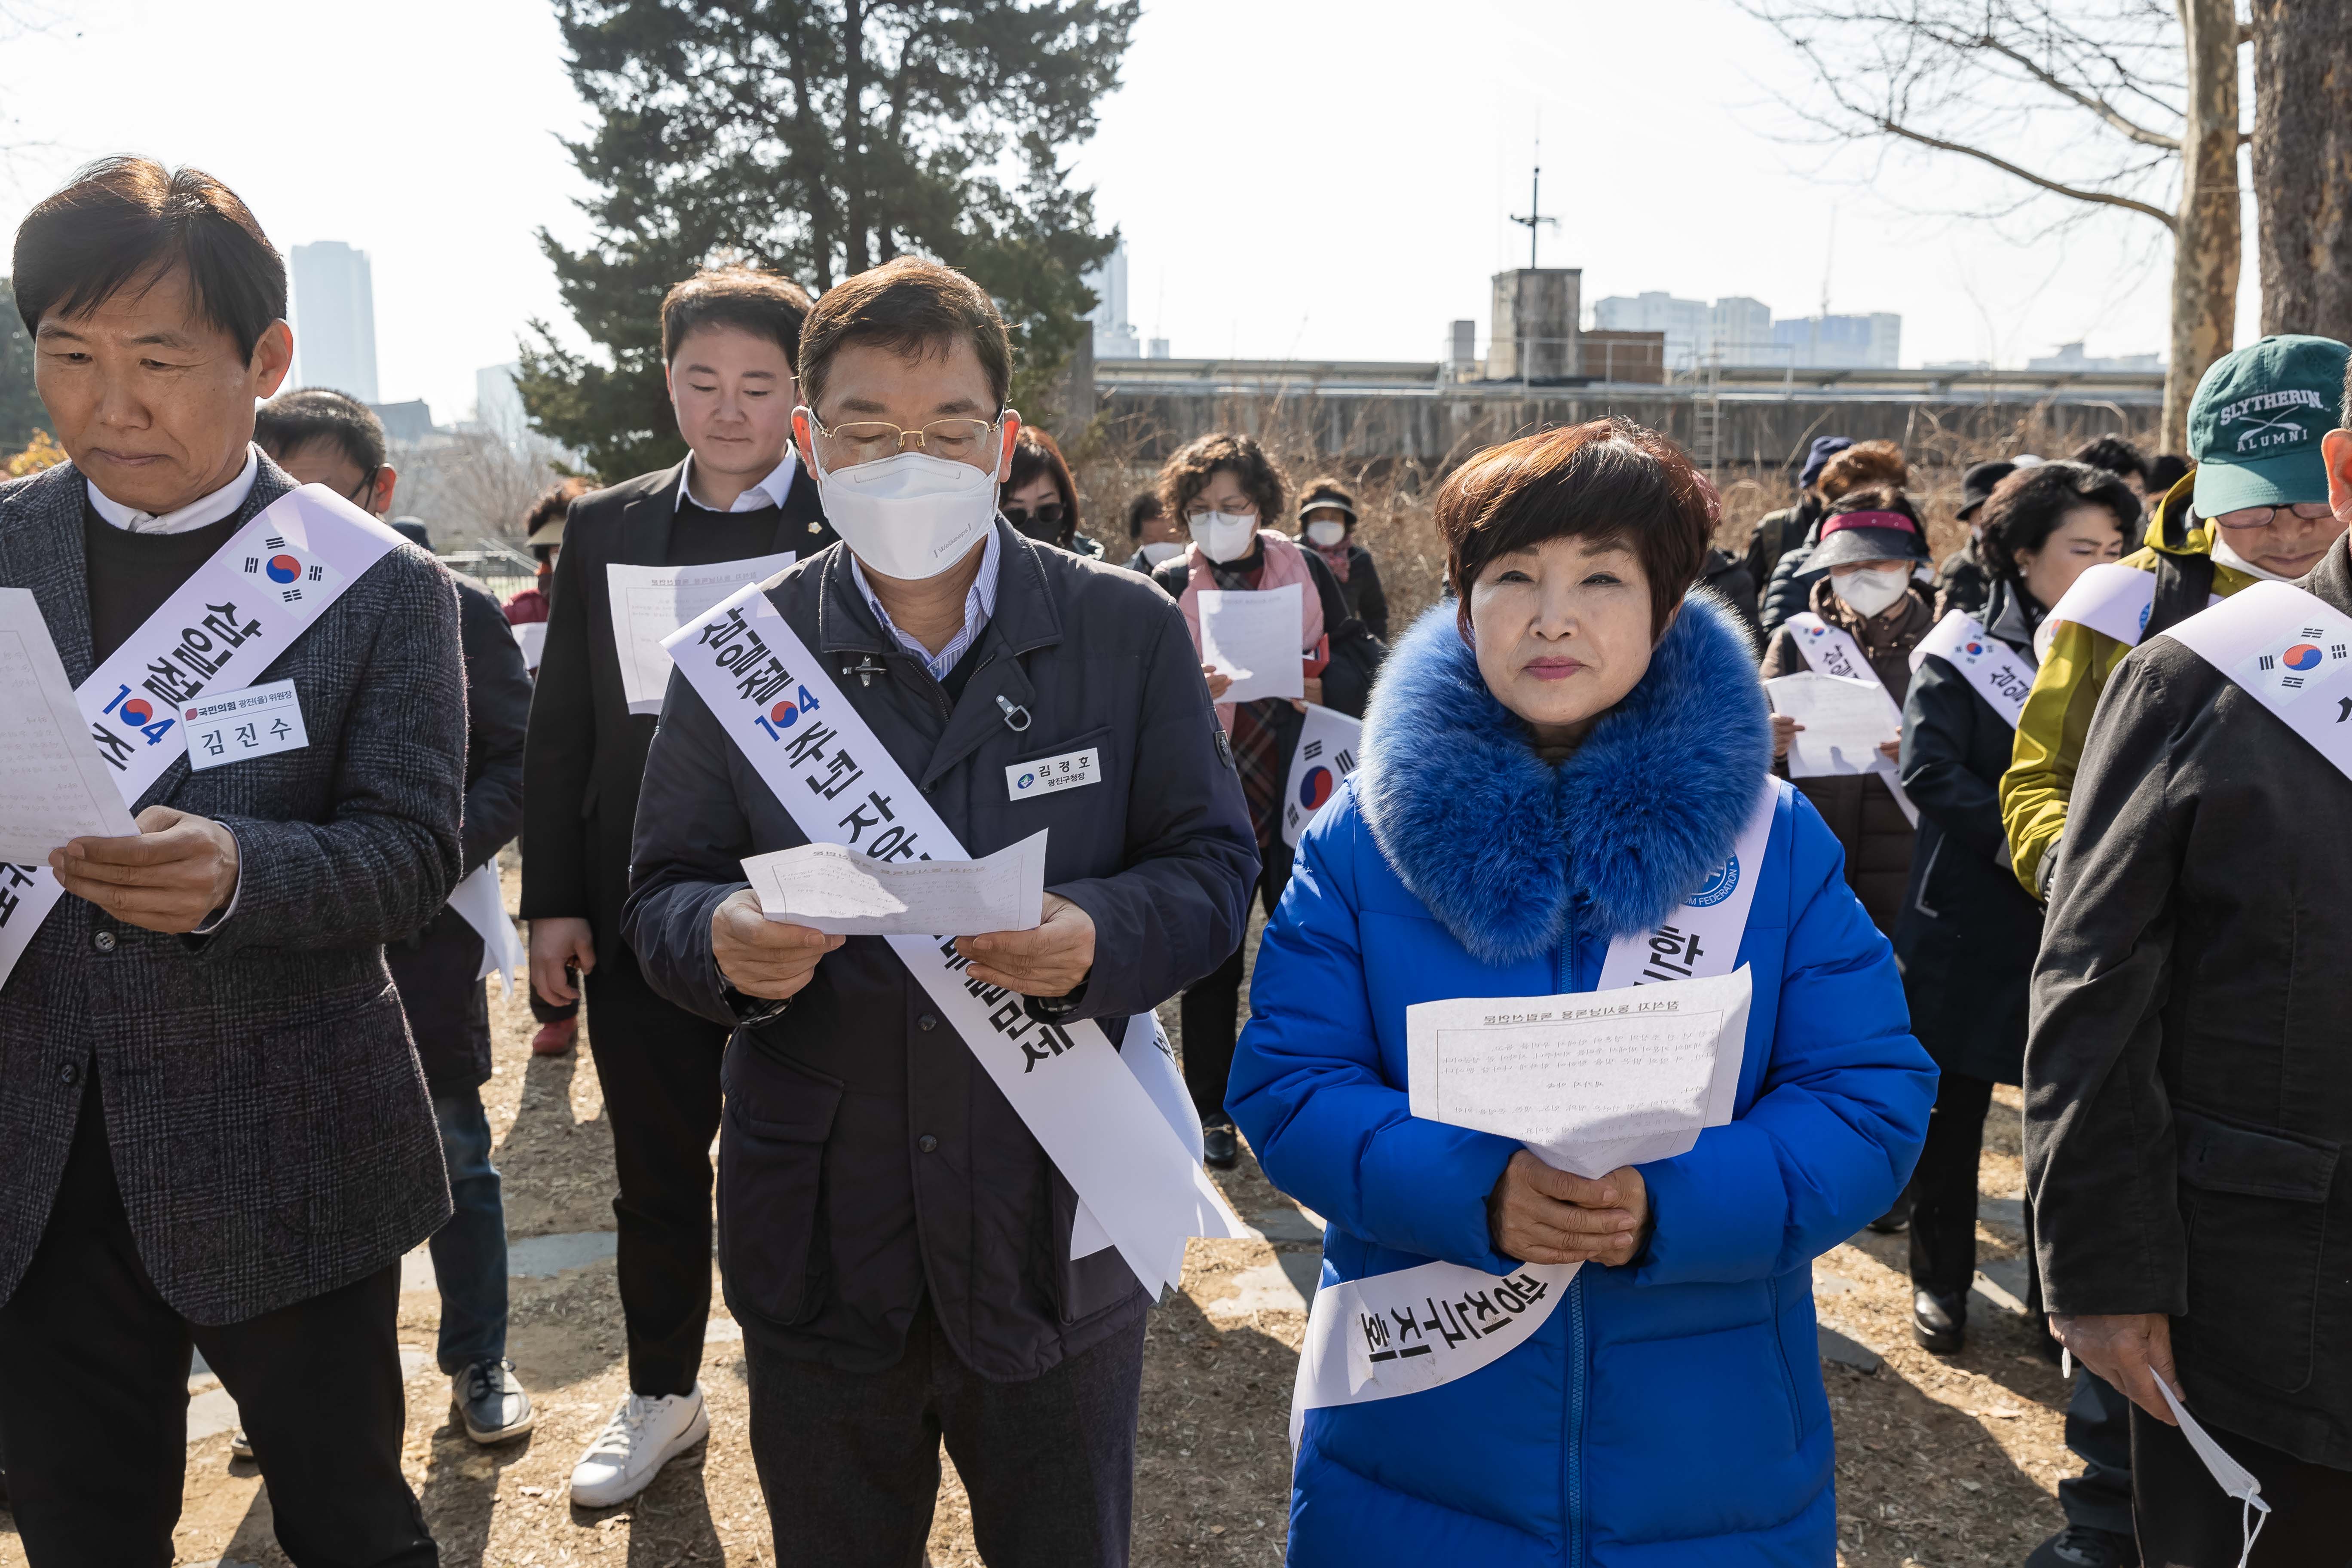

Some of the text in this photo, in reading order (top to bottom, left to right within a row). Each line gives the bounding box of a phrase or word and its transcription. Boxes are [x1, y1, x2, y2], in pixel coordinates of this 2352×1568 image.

[2220, 389, 2324, 426] SLYTHERIN
[2236, 429, 2307, 452] ALUMNI
[141, 601, 263, 711] 삼일절
[1822, 644, 1860, 679] 삼일
[198, 690, 292, 716] 국민의힘 광진(을) 위원장
[1990, 665, 2030, 708] 삼일
[697, 606, 795, 707] 삼일절
[784, 720, 864, 801] 주년
[838, 790, 932, 861] 자유
[1047, 772, 1085, 787] 광진구청장
[1698, 868, 1737, 906] FEDERATION
[1361, 1273, 1549, 1363] 광진구지회
